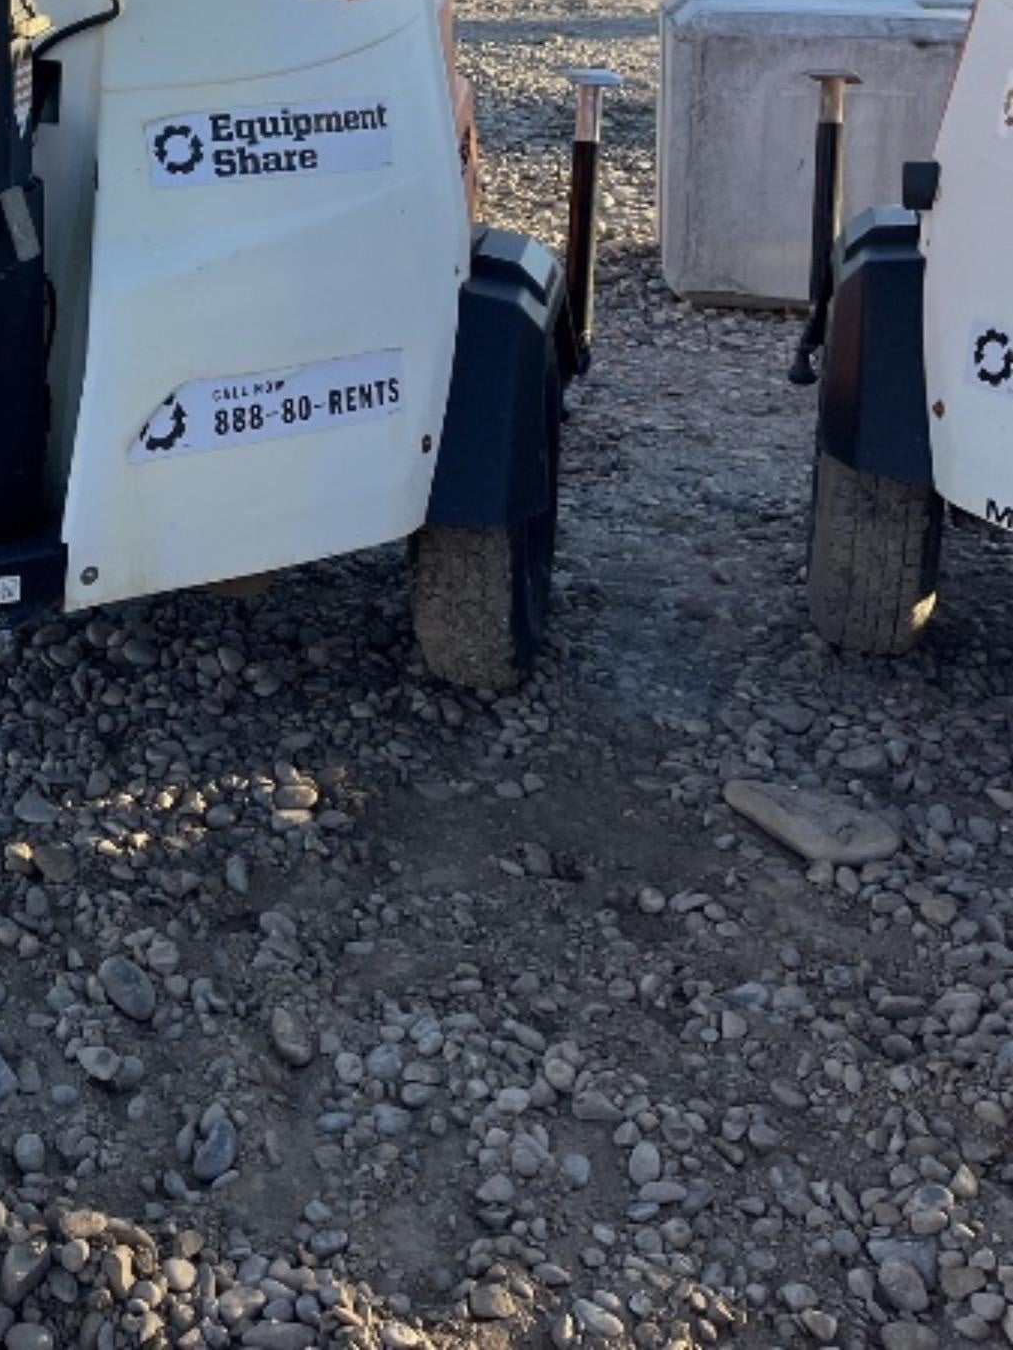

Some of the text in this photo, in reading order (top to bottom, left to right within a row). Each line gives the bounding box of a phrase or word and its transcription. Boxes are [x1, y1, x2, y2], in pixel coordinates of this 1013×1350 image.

[209, 103, 387, 145] Equipment
[213, 147, 318, 178] Share
[214, 377, 400, 436] 888-80-RENTS
